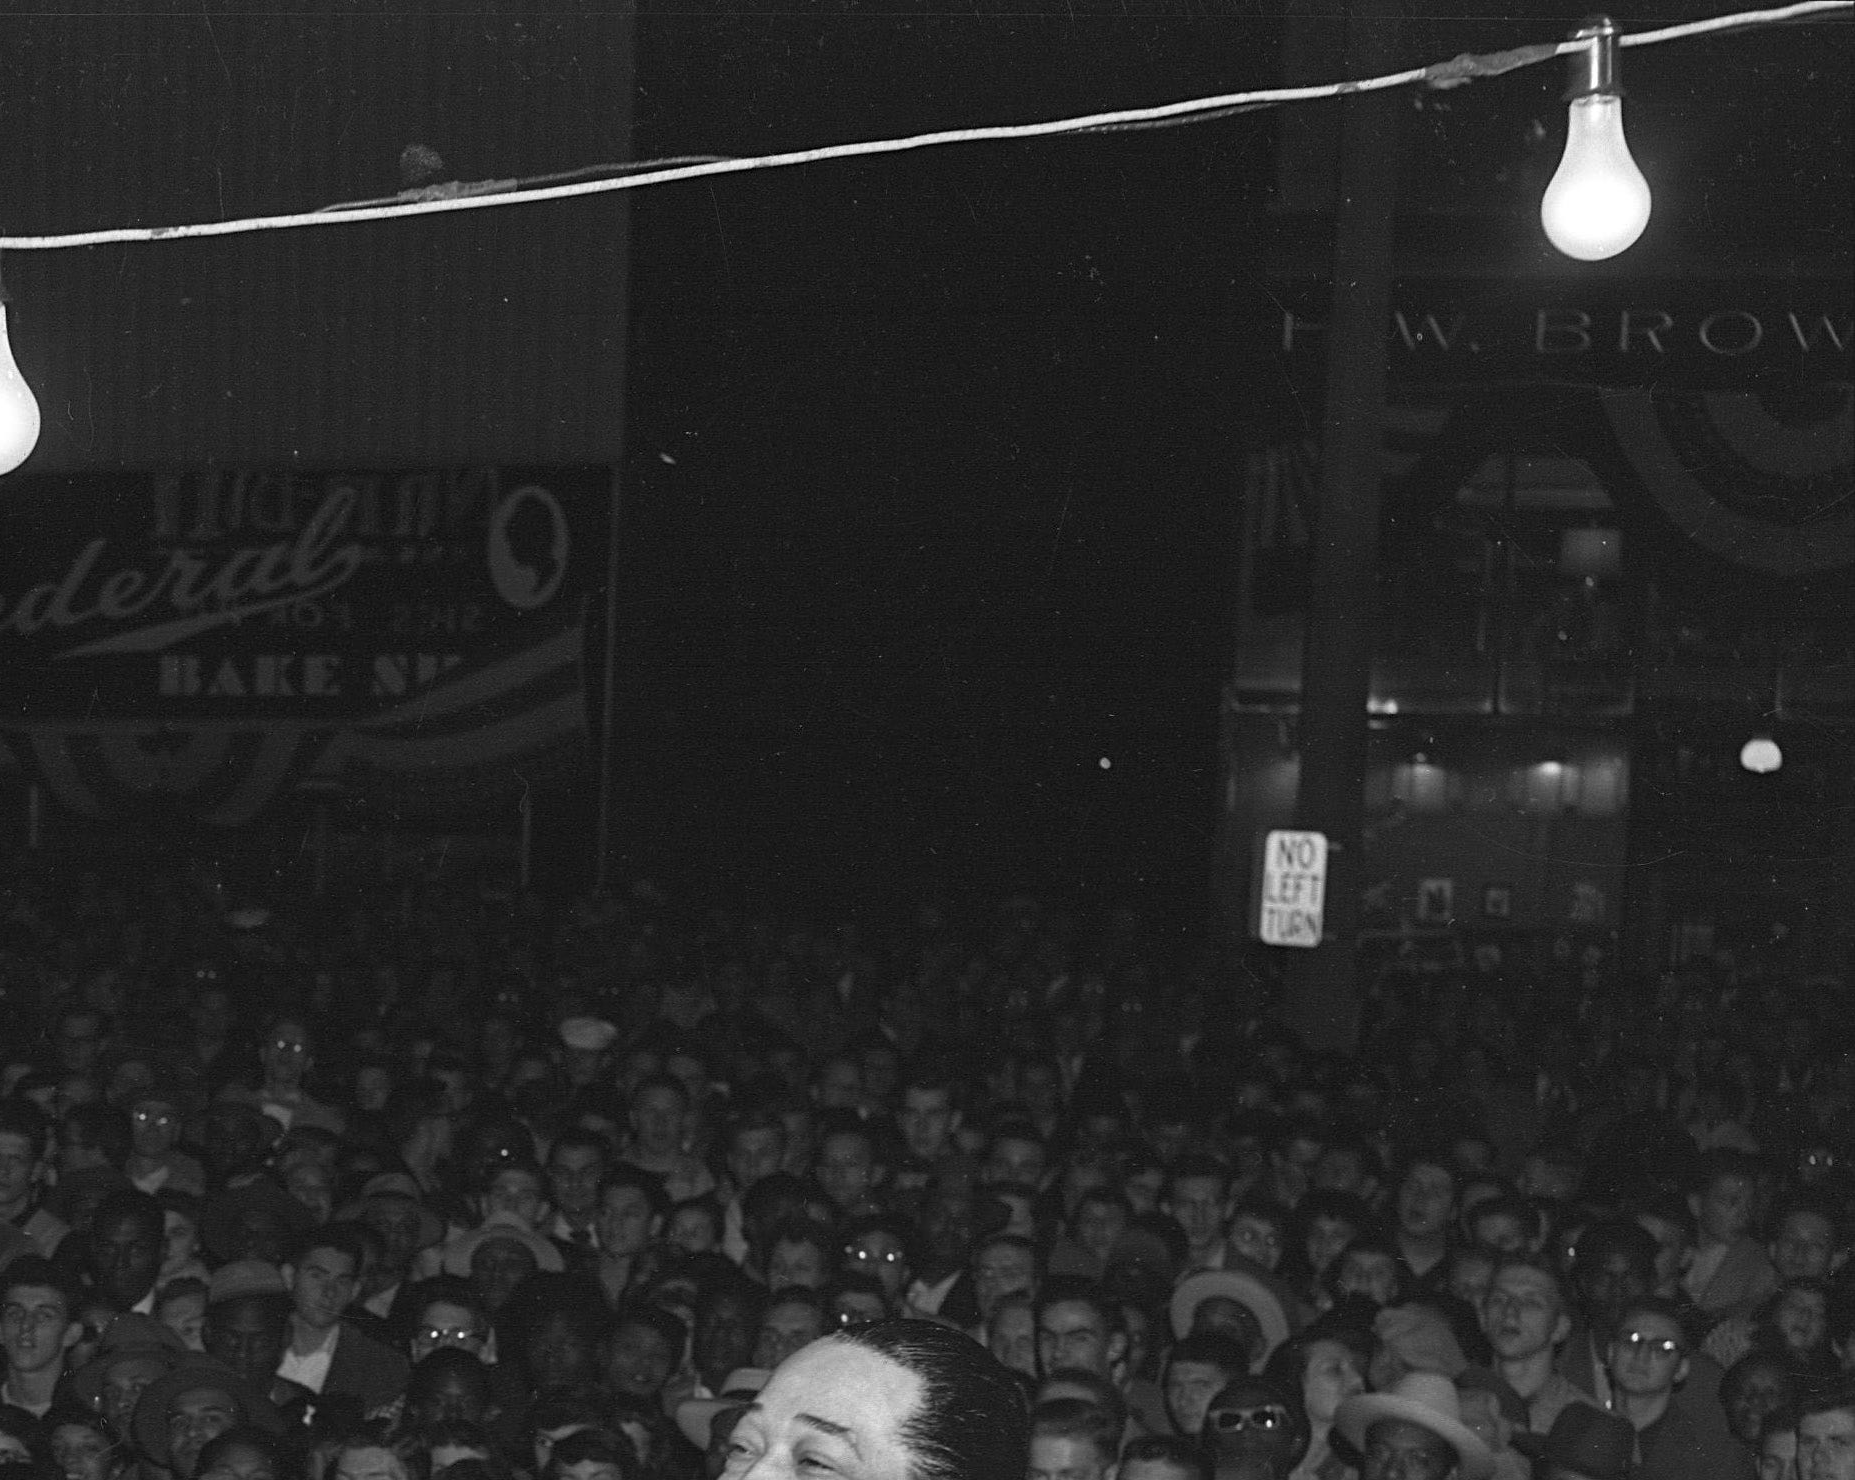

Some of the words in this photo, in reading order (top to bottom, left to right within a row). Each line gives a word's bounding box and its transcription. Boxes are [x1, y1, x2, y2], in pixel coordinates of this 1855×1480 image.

[157, 653, 343, 697] BAKE
[1276, 838, 1318, 869] NO
[1264, 871, 1322, 904] LEFT
[1264, 907, 1321, 940] TURN
